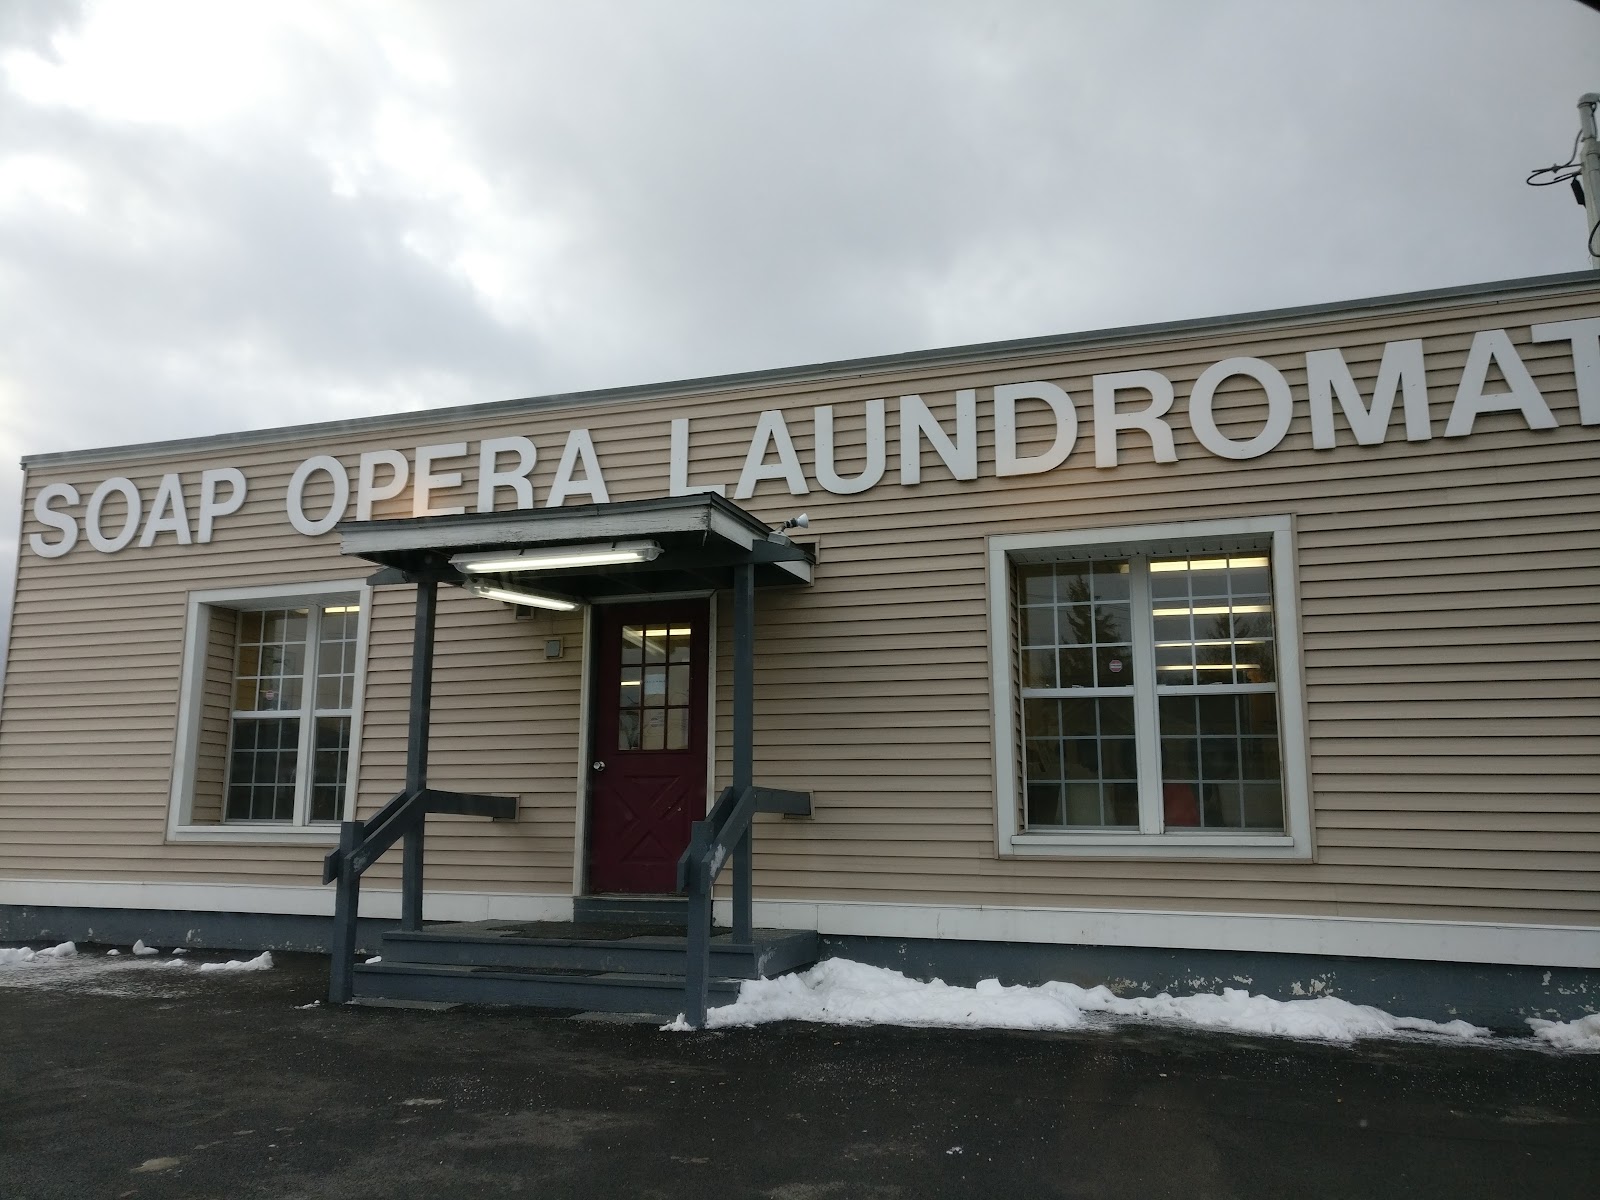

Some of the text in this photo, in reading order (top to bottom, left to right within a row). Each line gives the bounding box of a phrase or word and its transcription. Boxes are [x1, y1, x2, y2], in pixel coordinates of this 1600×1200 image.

[29, 317, 1600, 559] SOAP OPERA LAUNDROMAT
